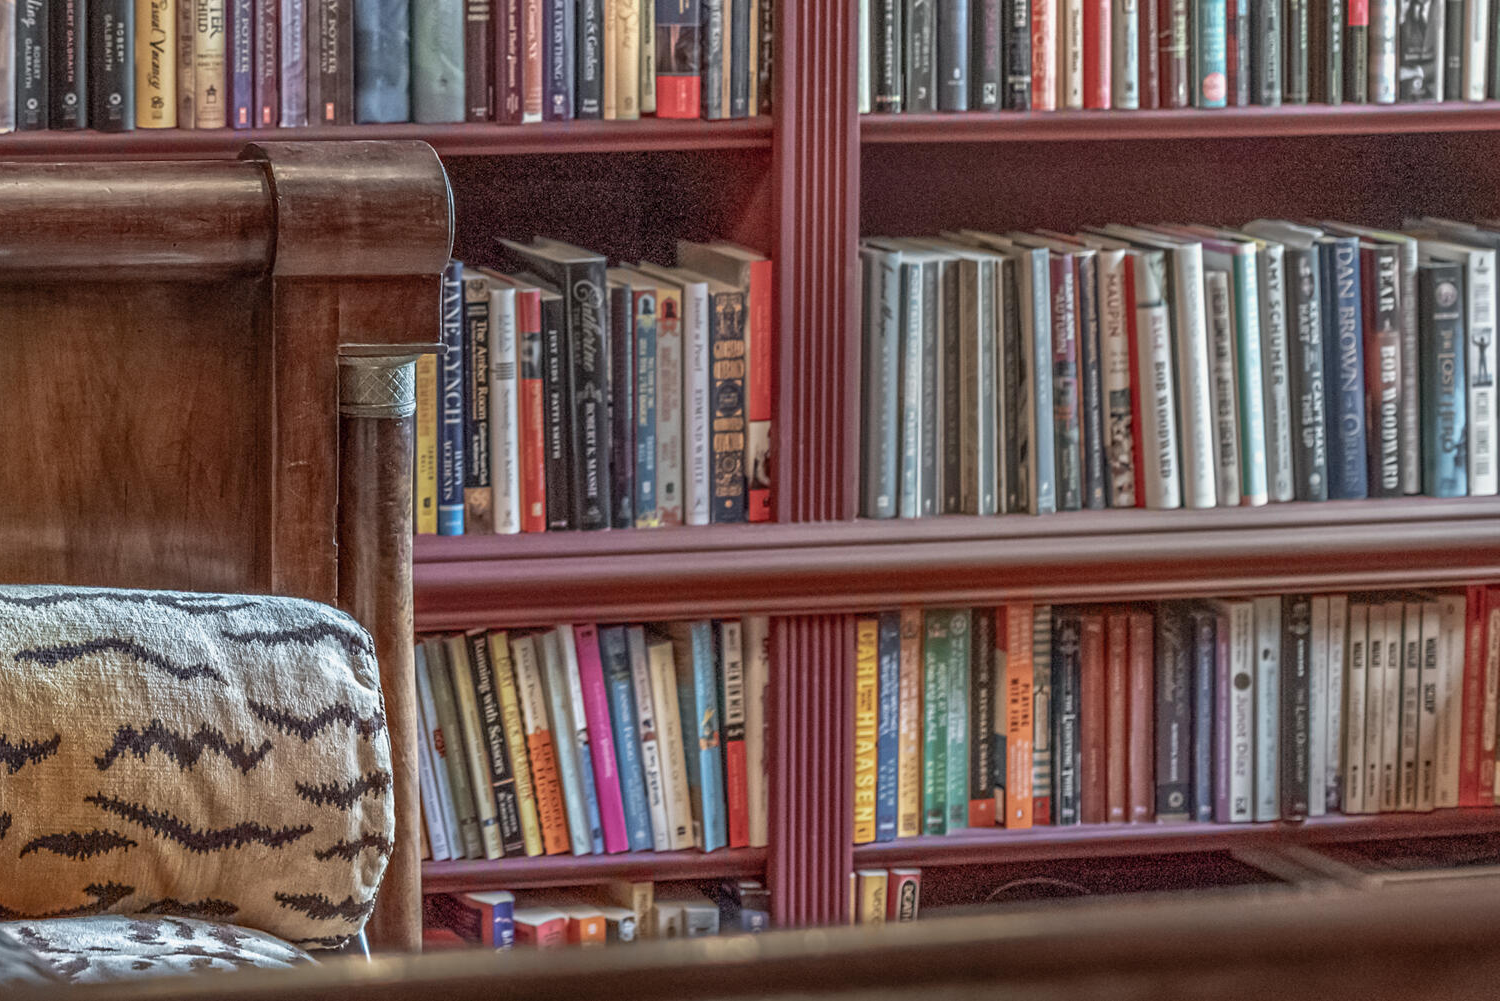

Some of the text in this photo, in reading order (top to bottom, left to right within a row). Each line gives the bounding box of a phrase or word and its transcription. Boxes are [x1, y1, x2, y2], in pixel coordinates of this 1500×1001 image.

[24, 37, 36, 89] GALBRAITH
[32, 45, 43, 80] ROBERT
[66, 29, 76, 83] GALBRAITH
[104, 13, 114, 72] GALBRAITH
[116, 22, 125, 64] ROBERT
[147, 40, 166, 90] Vacancy
[240, 18, 251, 73] POTTER
[264, 23, 276, 77] POTTER
[326, 18, 338, 75] POTTER
[554, 10, 565, 80] EVERYTHING
[588, 36, 599, 81] Gardens
[475, 320, 489, 342] The
[1065, 272, 1076, 341] MARY ANN
[1104, 272, 1123, 338] MAUPIN
[1268, 254, 1284, 386] AMY SCHUMER
[1298, 303, 1311, 343] HART
[1309, 299, 1320, 345] KEVIN
[1334, 246, 1359, 392] DAN BROWN
[443, 277, 463, 424] JANE LYNCH
[476, 346, 489, 381] Amber
[549, 329, 561, 355] JUST
[572, 279, 604, 498] Catherine ROBERT MASSIE
[1379, 255, 1399, 490] FEAR BOB WOODWARD
[477, 386, 490, 420] Room
[551, 393, 562, 424] PATTI
[1153, 360, 1173, 480] BOB WOODWARD
[1302, 394, 1313, 449] THIS UP
[454, 449, 464, 486] HAPPY
[552, 425, 563, 460] SMITH
[444, 440, 455, 501] ACCIDENTS
[473, 639, 507, 775] Running with Scissors
[854, 629, 876, 822] CARL HIAASEN
[1010, 678, 1020, 734] WITH FIRE
[1021, 683, 1030, 728] PLAYING
